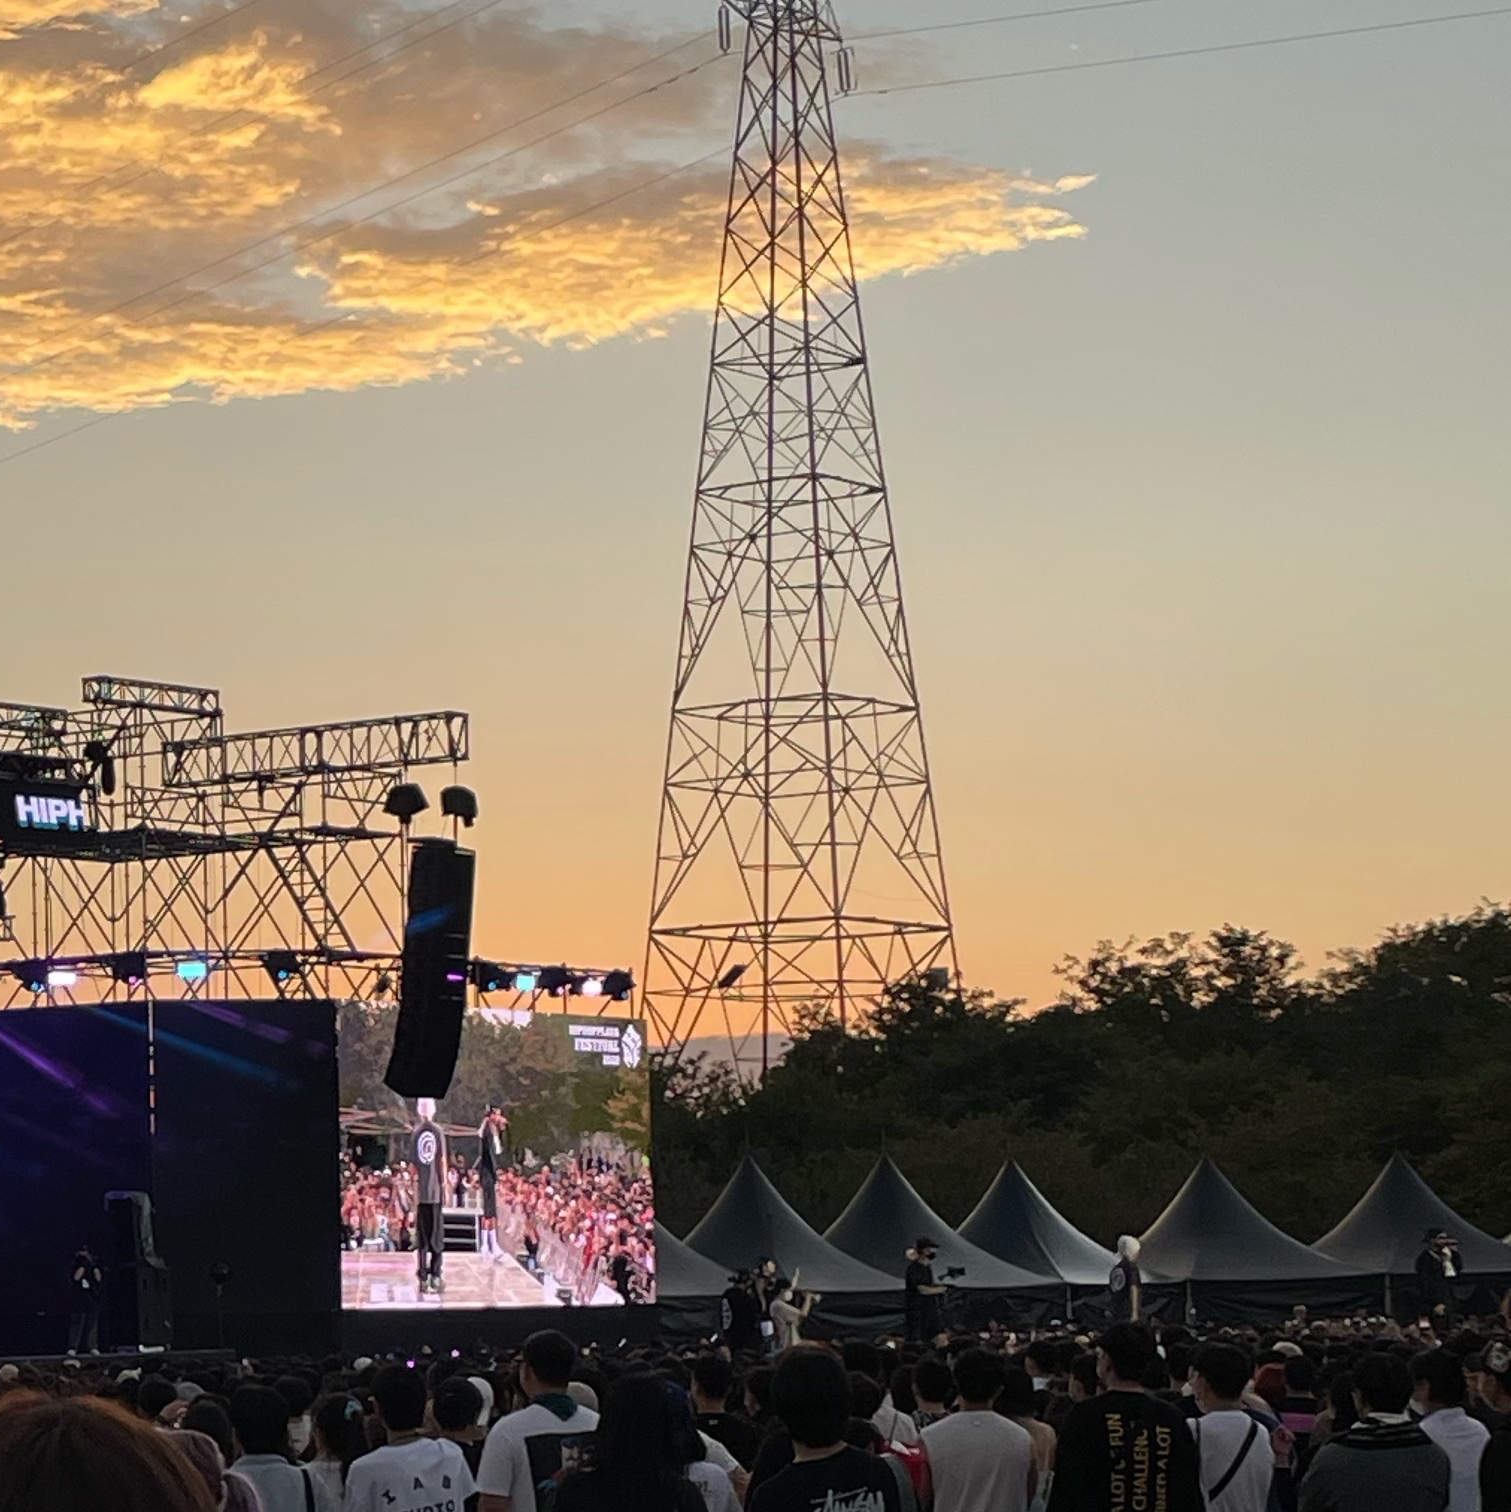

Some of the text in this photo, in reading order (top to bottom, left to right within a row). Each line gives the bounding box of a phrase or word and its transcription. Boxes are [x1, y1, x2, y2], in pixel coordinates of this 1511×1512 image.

[15, 793, 89, 833] HIPH
[1104, 1412, 1125, 1447] FUN
[1155, 1424, 1172, 1456] LOT
[1129, 1420, 1149, 1511] CHALLENG
[1110, 1472, 1126, 1502] LOT
